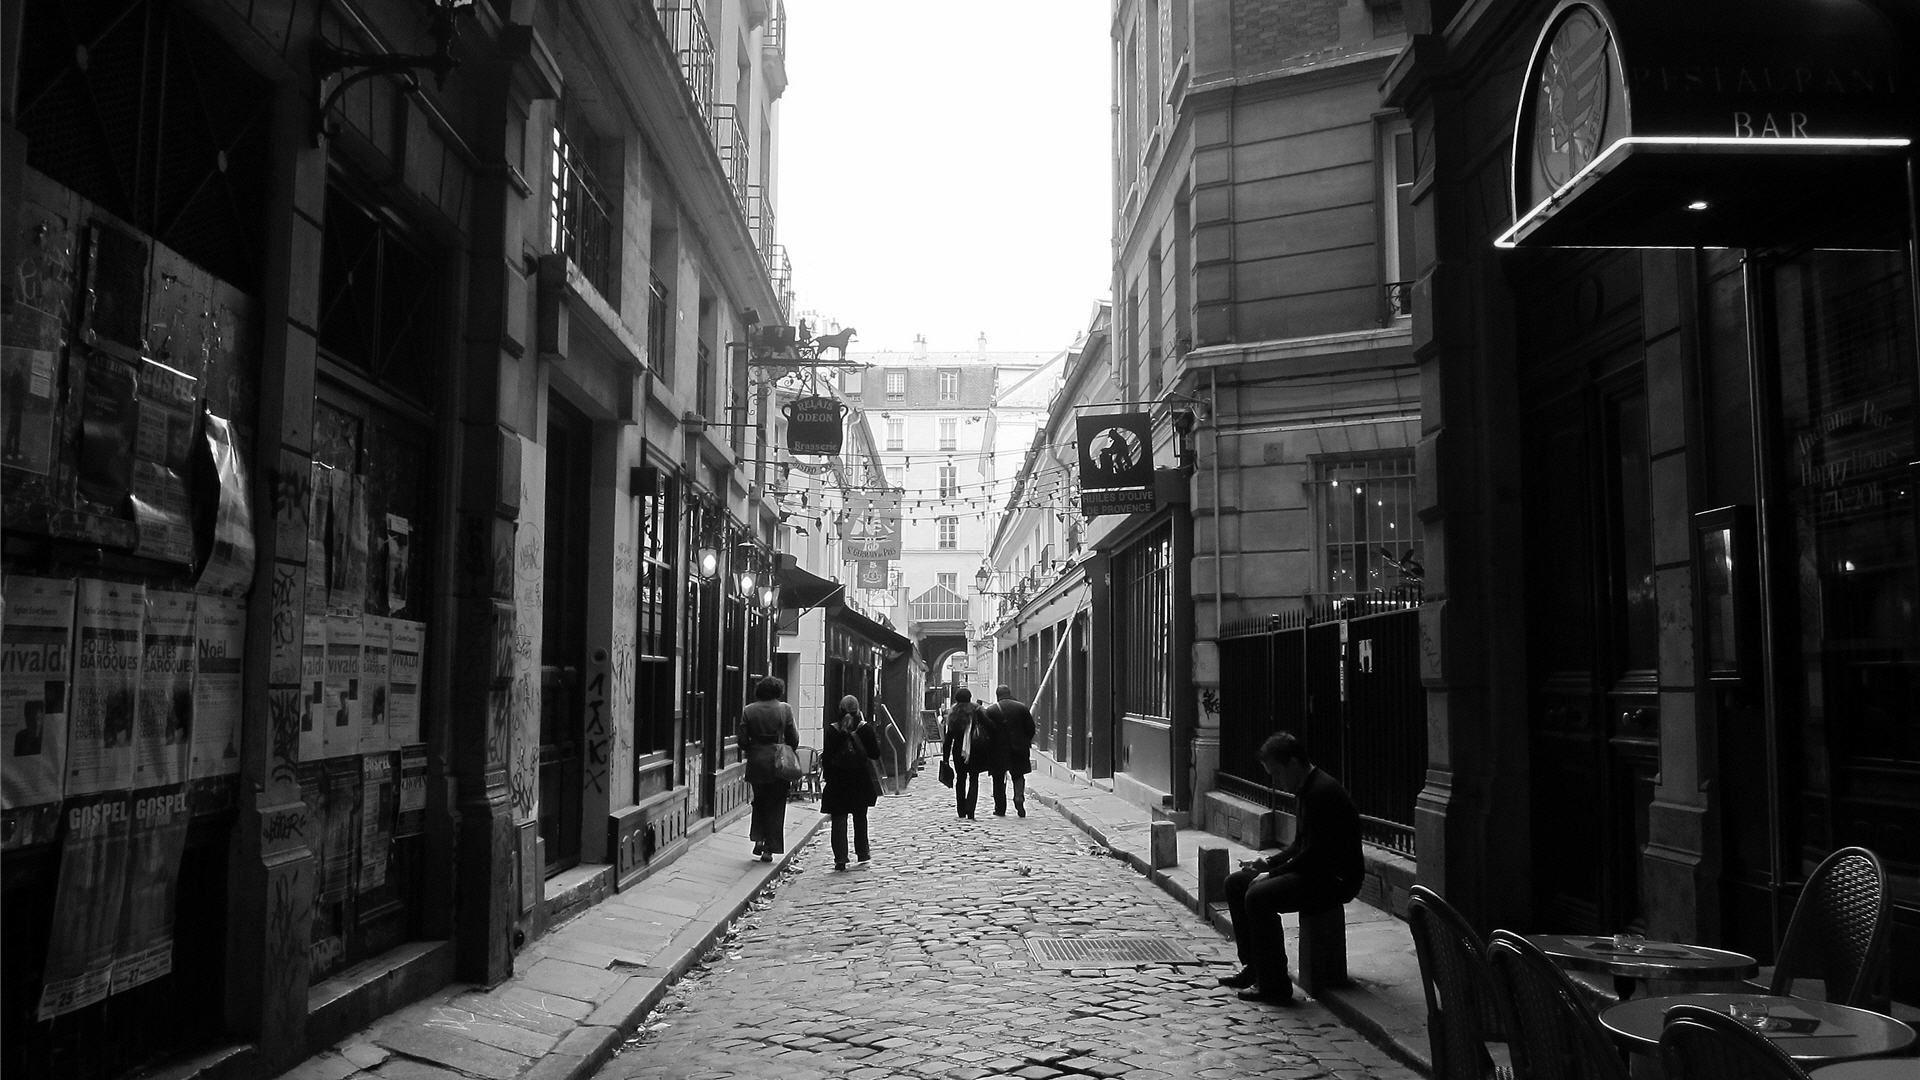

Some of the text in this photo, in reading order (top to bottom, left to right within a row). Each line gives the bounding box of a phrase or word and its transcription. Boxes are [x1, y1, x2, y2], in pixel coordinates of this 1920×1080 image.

[1734, 112, 1809, 139] BAR
[796, 398, 834, 411] RELAIS
[796, 412, 834, 423] ODEON
[794, 441, 838, 451] Brasserie
[1800, 448, 1897, 490] Happy Hours
[1082, 491, 1153, 503] HUILES D'OLIVE
[1086, 503, 1151, 515] DE PROVENCE
[82, 639, 118, 656] FOLIES
[198, 638, 227, 659] Noël
[1, 643, 67, 673] vivaldi
[80, 654, 138, 671] BAROQUES
[136, 792, 188, 820] GOSPEL
[68, 800, 129, 831] GOSPEL
